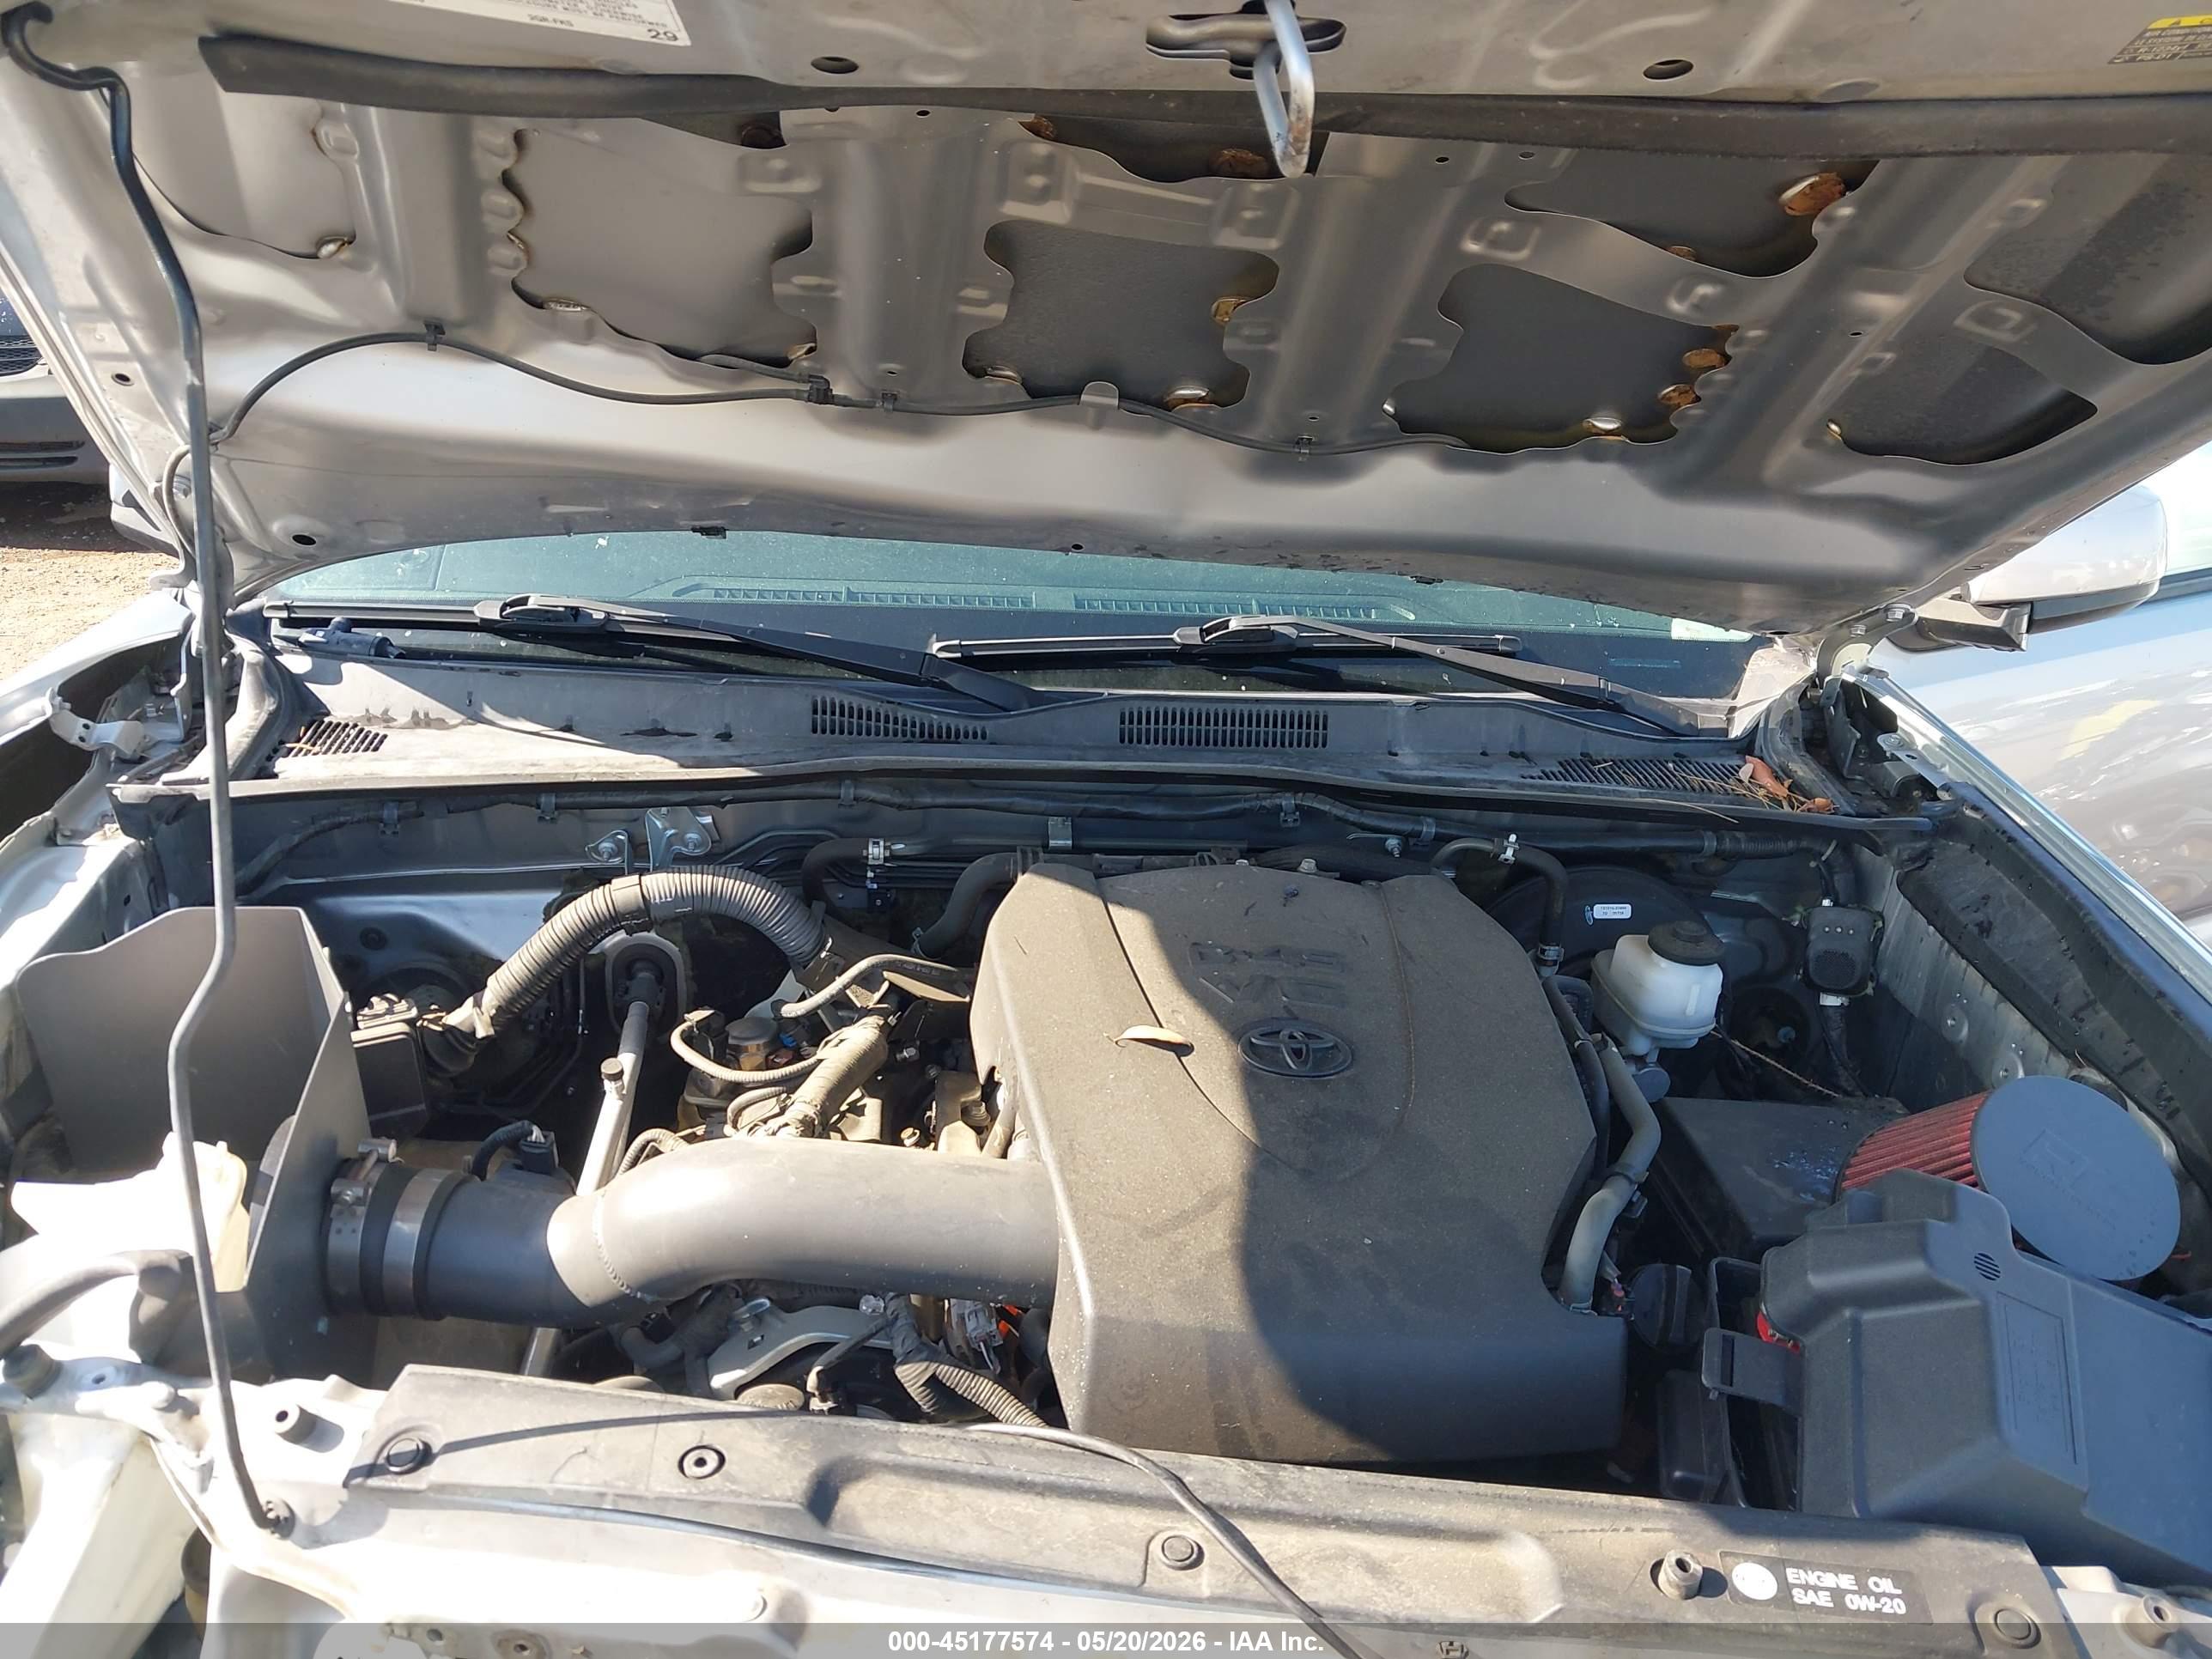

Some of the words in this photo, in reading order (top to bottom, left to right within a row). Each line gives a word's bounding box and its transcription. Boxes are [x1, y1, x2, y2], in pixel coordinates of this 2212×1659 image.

[647, 28, 678, 42] 29
[1785, 1567, 1859, 1590] ENGINE
[1867, 1576, 1903, 1595] OIL
[1791, 1588, 1834, 1607] SAE
[1844, 1594, 1907, 1614] 0W-20
